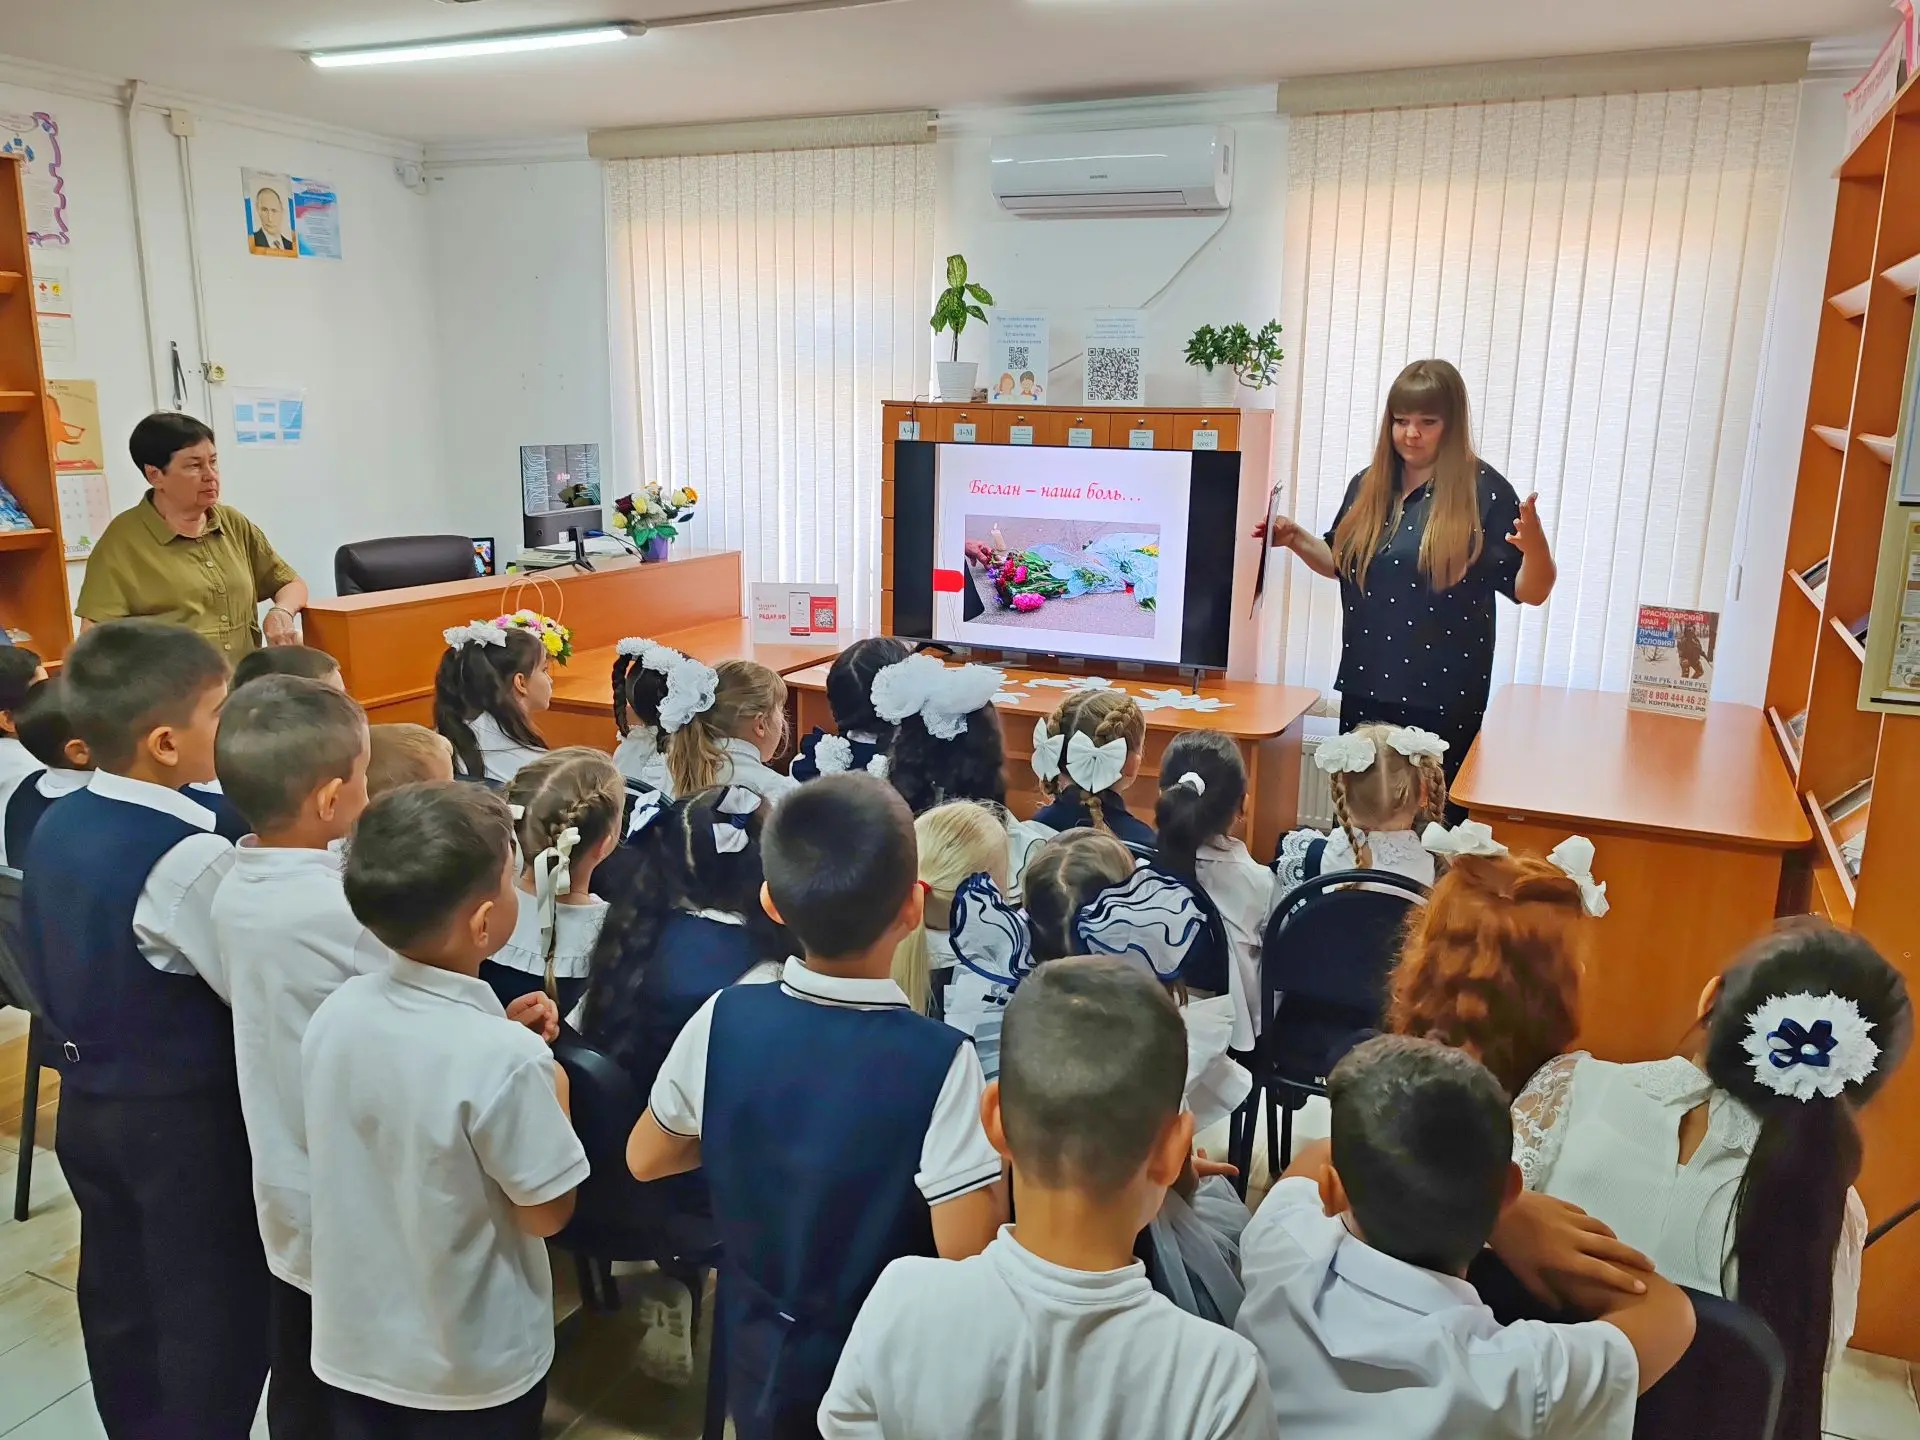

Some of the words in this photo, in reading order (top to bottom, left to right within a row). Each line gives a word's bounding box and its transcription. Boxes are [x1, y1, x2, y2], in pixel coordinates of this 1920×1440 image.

[969, 479, 1021, 496] Беслан
[1041, 486, 1081, 499] наша
[1086, 482, 1141, 501] боль...
[1641, 609, 1704, 622] КРАСНОДАРСКИЙ
[1640, 617, 1659, 626] КРАЙ
[1639, 628, 1670, 638] ЛУЧШИЕ
[1639, 637, 1674, 647] УСЛОВИЯ!
[1648, 699, 1706, 712] КОНТРАКТ23.РФ
